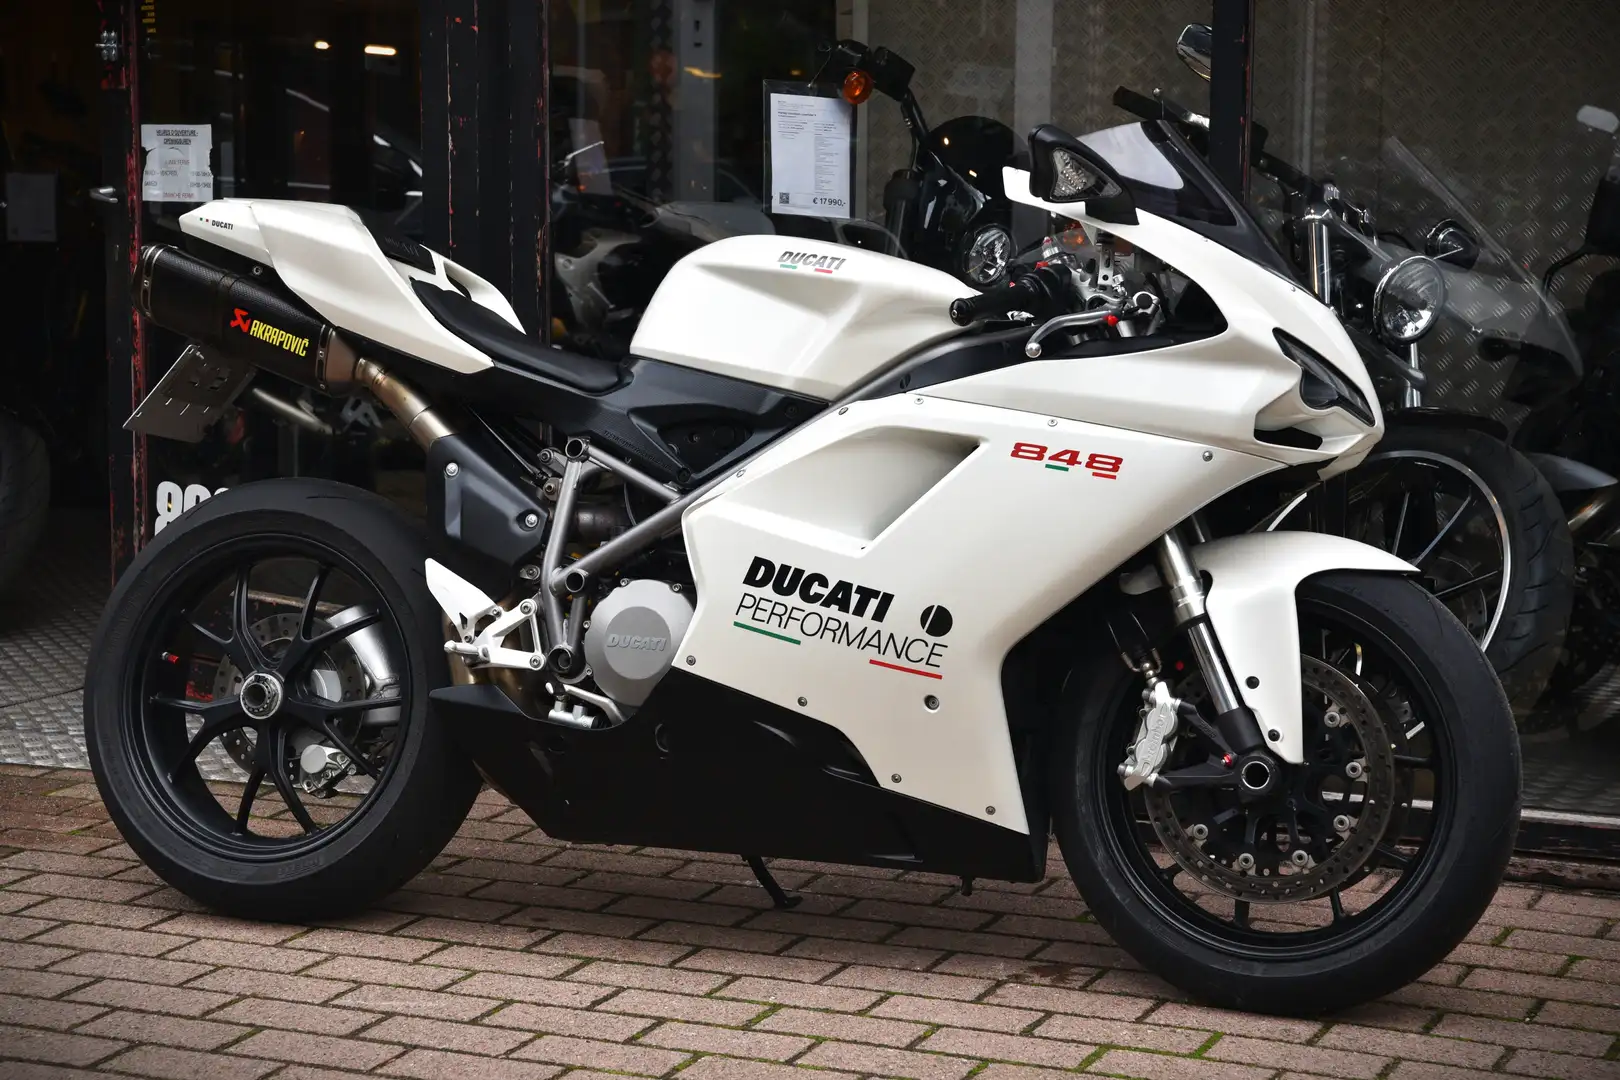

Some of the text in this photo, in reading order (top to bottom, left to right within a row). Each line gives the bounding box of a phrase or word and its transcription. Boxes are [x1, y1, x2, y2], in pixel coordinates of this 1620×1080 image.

[812, 197, 818, 205] €
[211, 219, 234, 230] DUCATI
[778, 251, 847, 270] DUCATI
[1010, 442, 1124, 473] 848
[742, 555, 895, 623] DUCATI
[735, 592, 949, 668] PERFORMANCE
[607, 633, 667, 651] DUCATI
